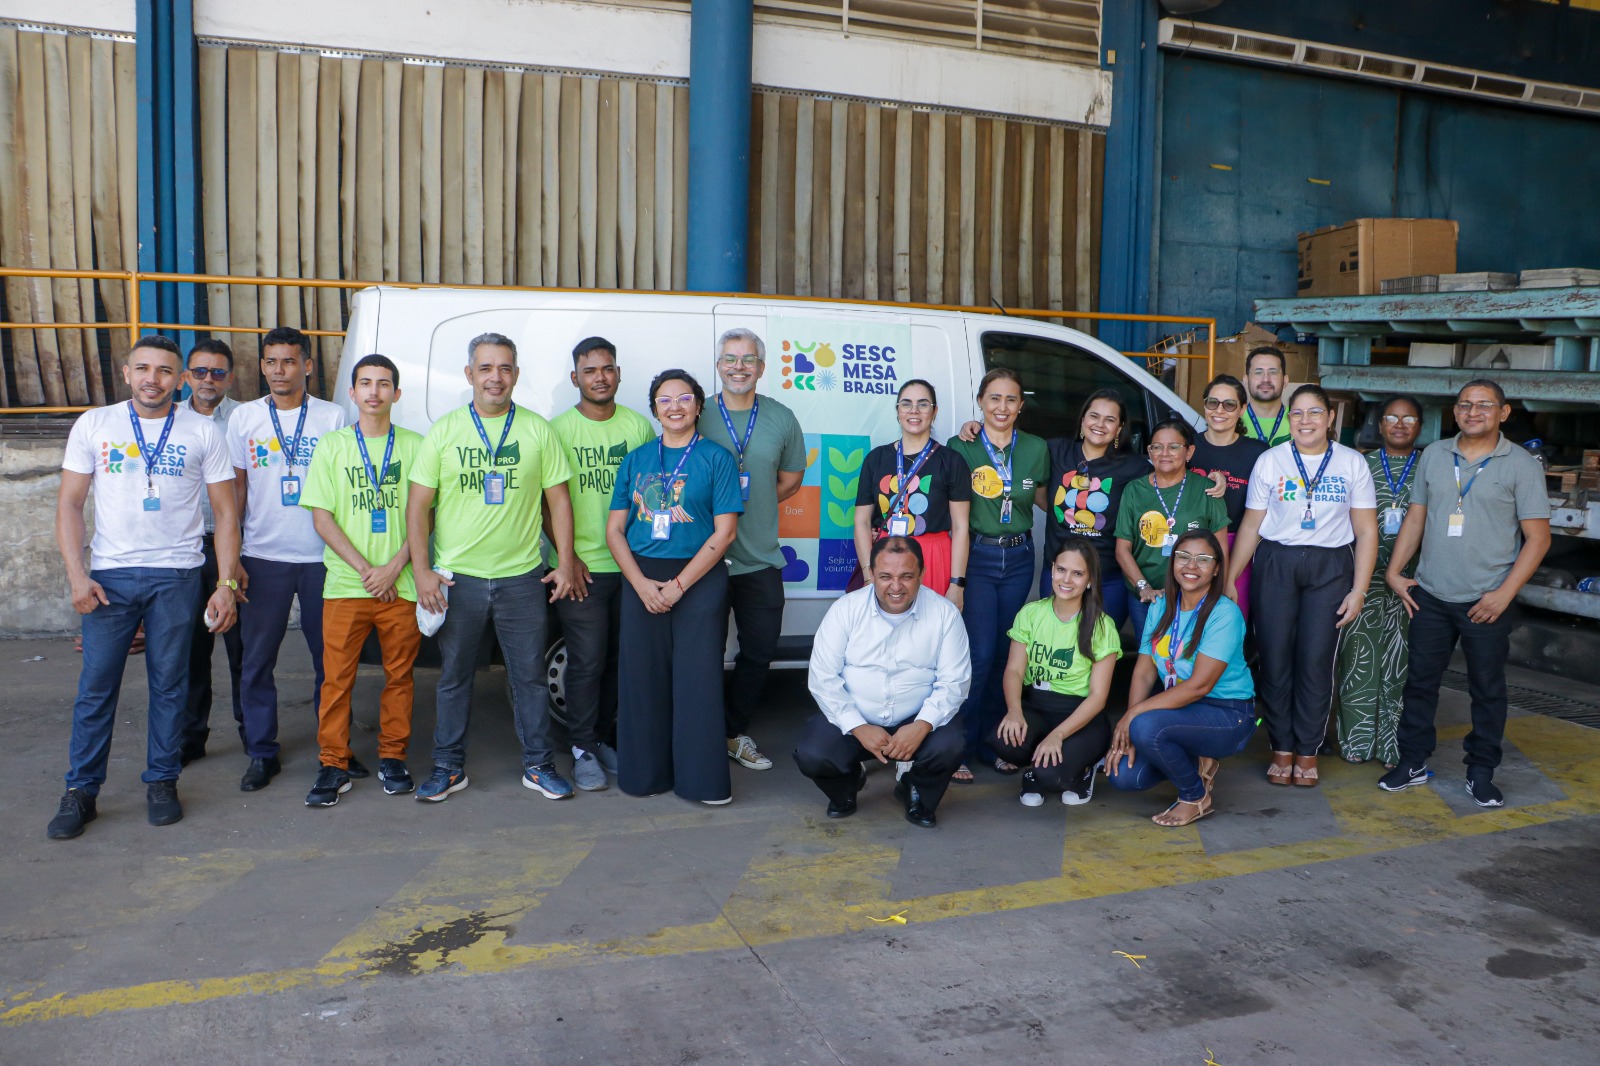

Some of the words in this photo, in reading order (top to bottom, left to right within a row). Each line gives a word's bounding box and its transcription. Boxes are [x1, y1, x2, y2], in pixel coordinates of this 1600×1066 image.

[842, 343, 896, 362] SESC
[843, 362, 897, 380] MESA
[843, 380, 898, 395] BRASIL
[285, 435, 319, 447] SSC
[146, 442, 187, 456] SSC
[456, 446, 492, 468] VEM
[497, 456, 515, 465] PRO
[573, 445, 605, 468] VEM
[460, 467, 519, 494] PARUE
[1314, 483, 1347, 495] MESA
[1314, 494, 1346, 503] BRASIL
[785, 506, 804, 515] Doe
[828, 556, 845, 566] Seja
[1052, 659, 1068, 668] PRO
